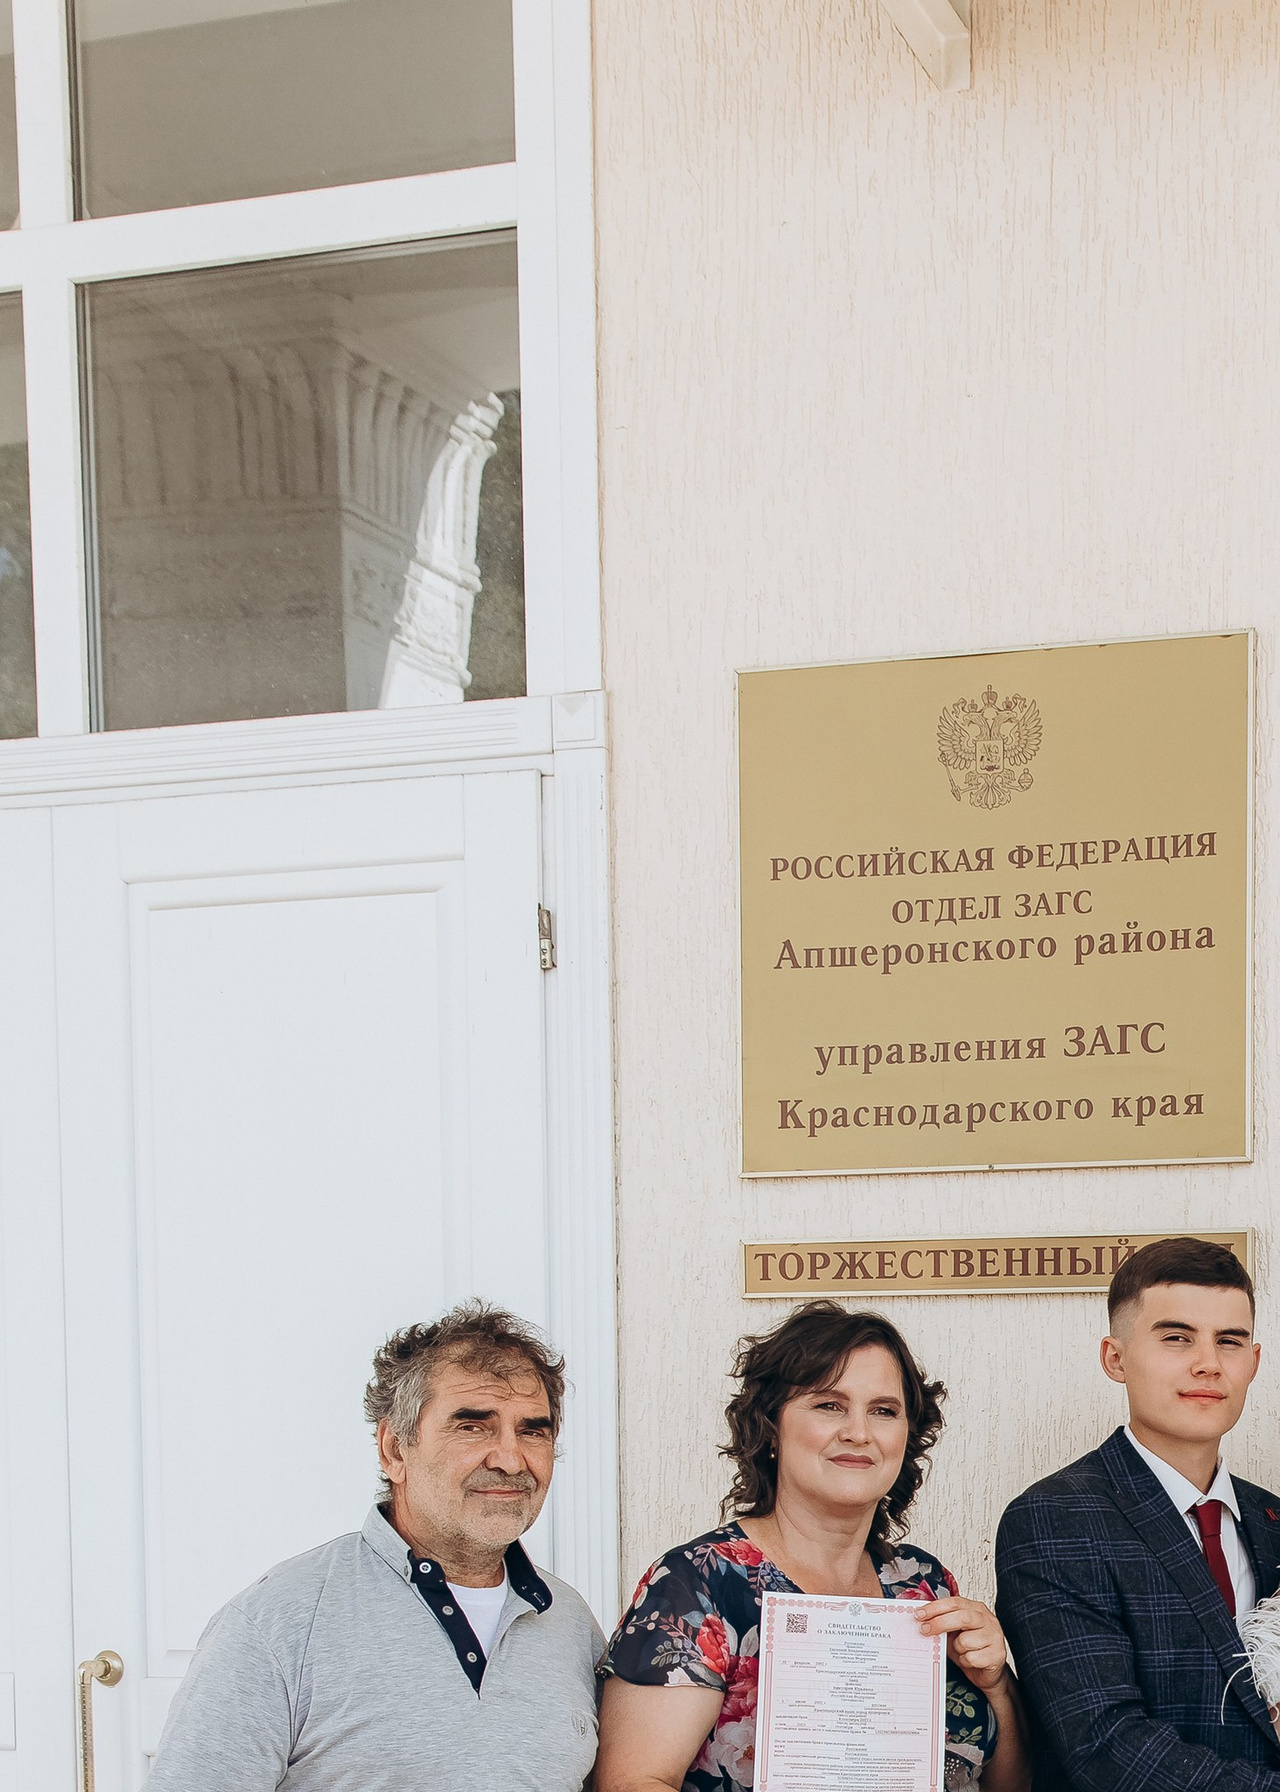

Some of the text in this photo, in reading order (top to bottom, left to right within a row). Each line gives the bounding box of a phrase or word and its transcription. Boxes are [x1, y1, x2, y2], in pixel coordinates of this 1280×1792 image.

[770, 831, 1218, 882] РОССИЙСКАЯ ФЕДЕРАЦИЯ
[891, 889, 1093, 927] ОТДЕЛ ЗАГС
[773, 921, 1216, 975] Апшеронского района
[813, 1022, 1167, 1076] управления ЗАГС
[777, 1093, 1205, 1138] Краснодарского края
